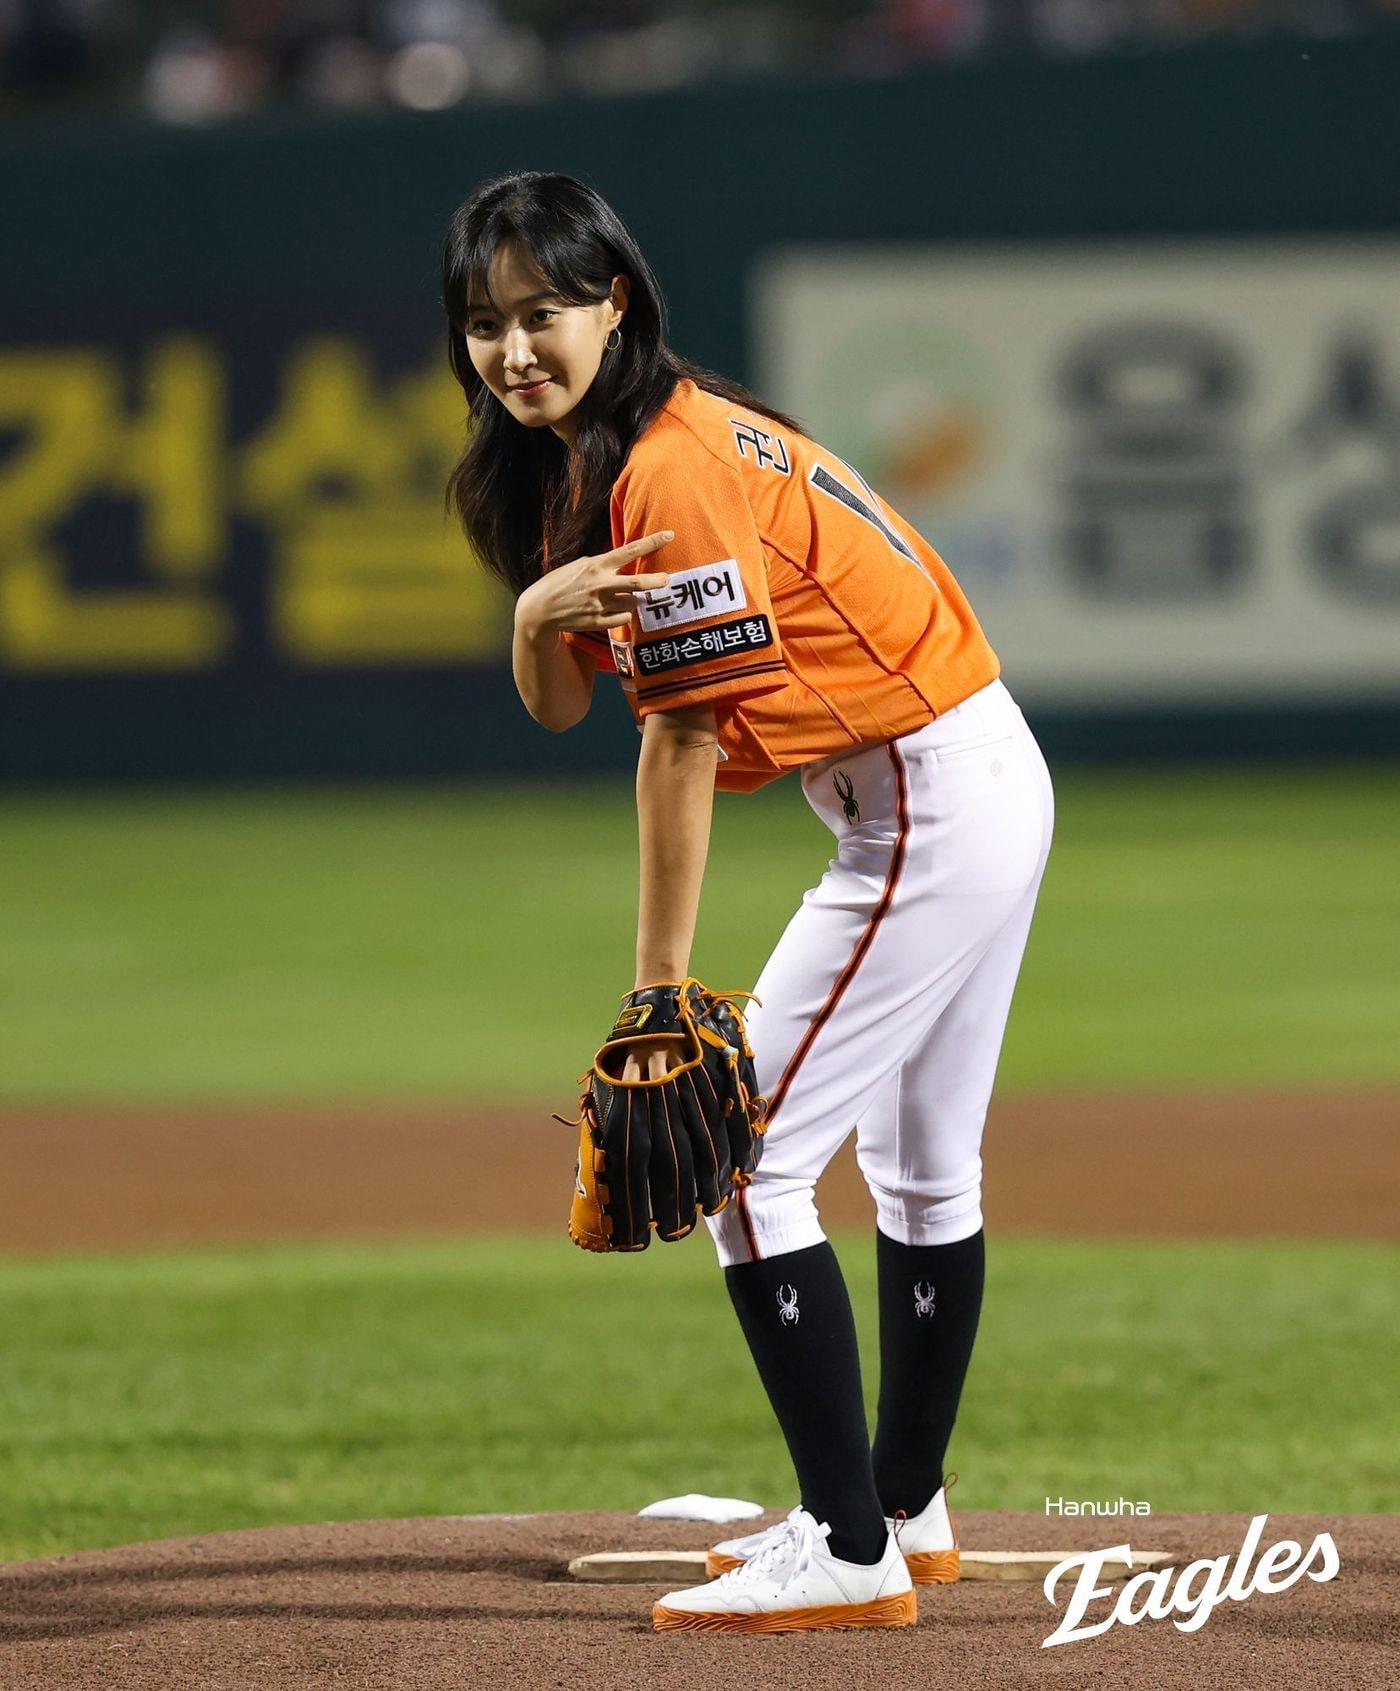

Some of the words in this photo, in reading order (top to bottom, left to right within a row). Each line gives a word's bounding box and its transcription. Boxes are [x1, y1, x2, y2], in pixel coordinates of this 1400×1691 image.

[728, 418, 792, 476] 권
[645, 570, 736, 620] 뉴케어
[638, 619, 768, 669] 한화손해보험
